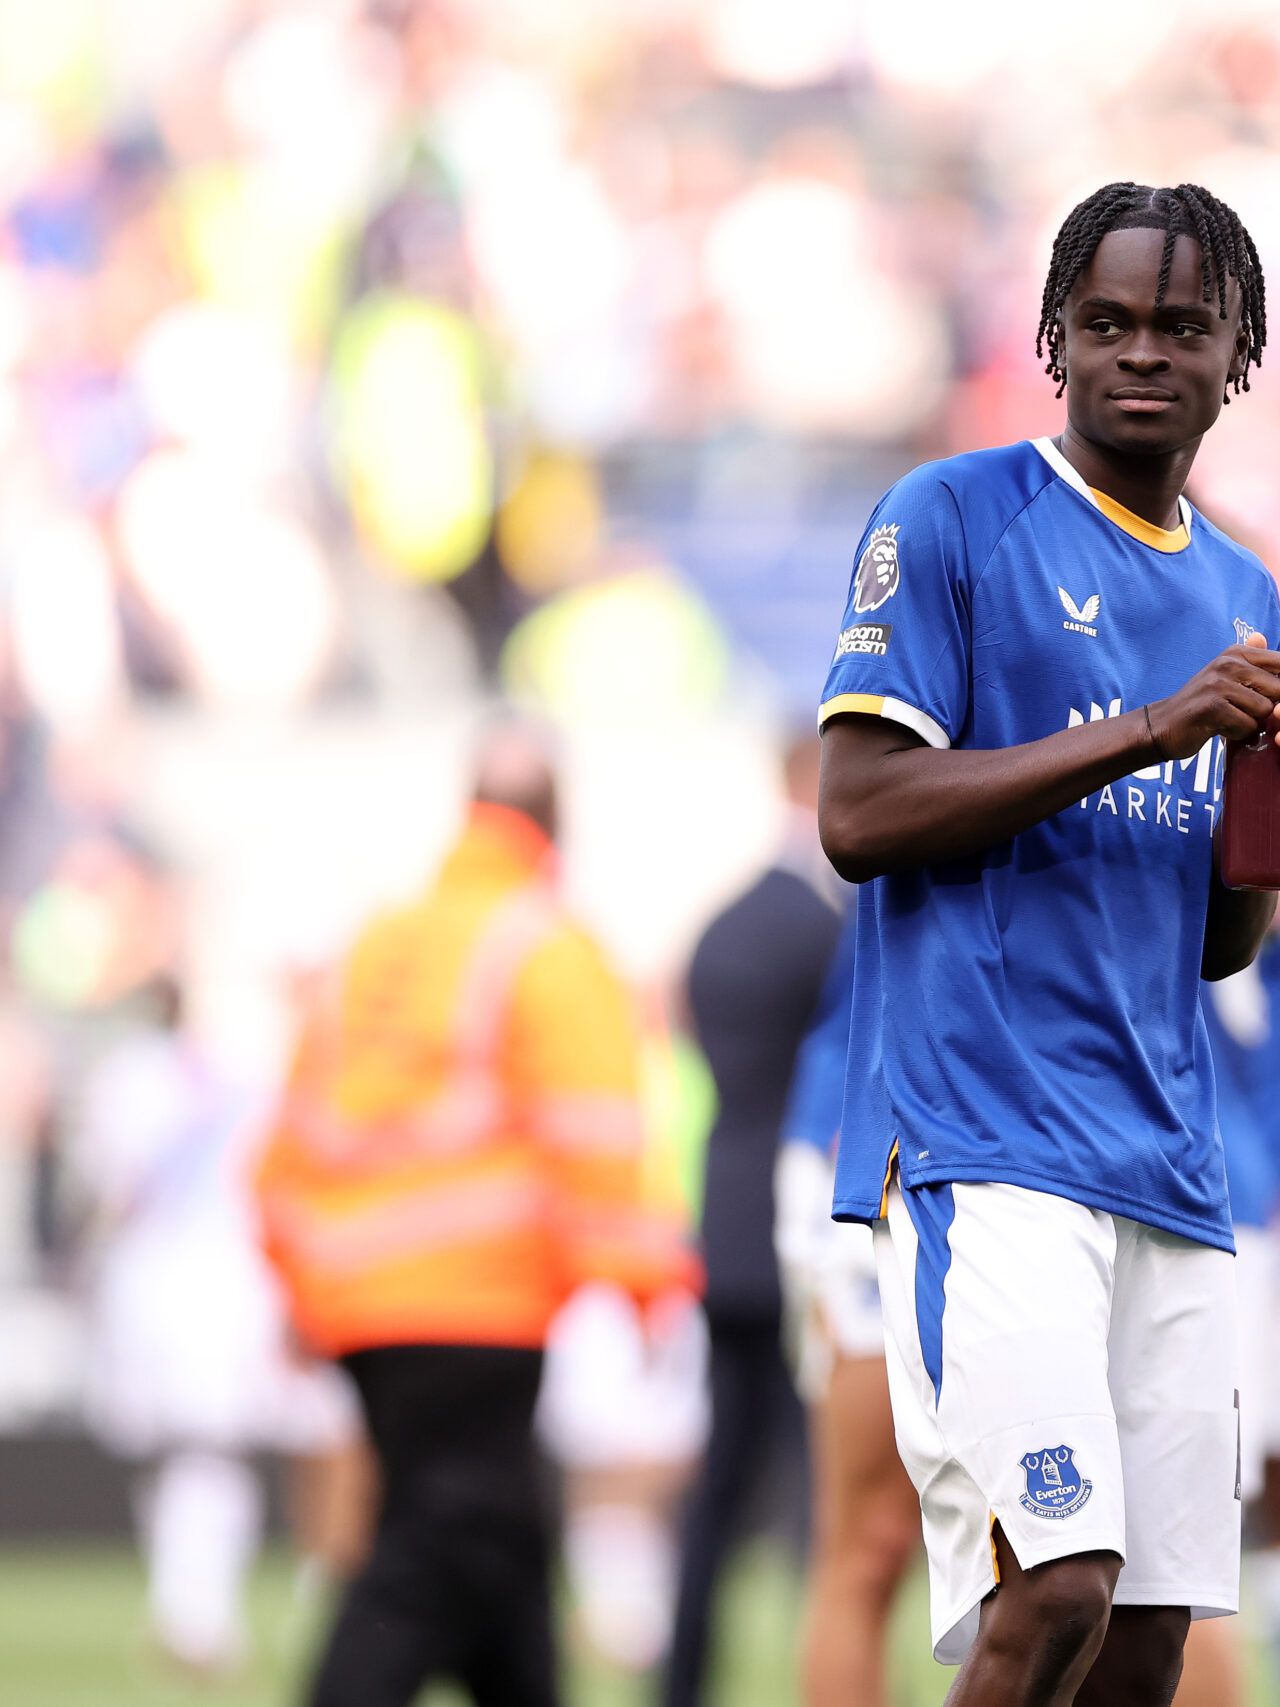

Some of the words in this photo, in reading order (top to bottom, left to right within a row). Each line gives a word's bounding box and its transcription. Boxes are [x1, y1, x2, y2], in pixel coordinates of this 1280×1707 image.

[1063, 621, 1098, 637] CASTORE
[1080, 784, 1215, 838] ARKET
[1025, 1502, 1035, 1512] NIL
[1036, 1509, 1054, 1517] SATIS
[1071, 1488, 1091, 1512] OPTIMUM
[1036, 1485, 1077, 1500] Everton
